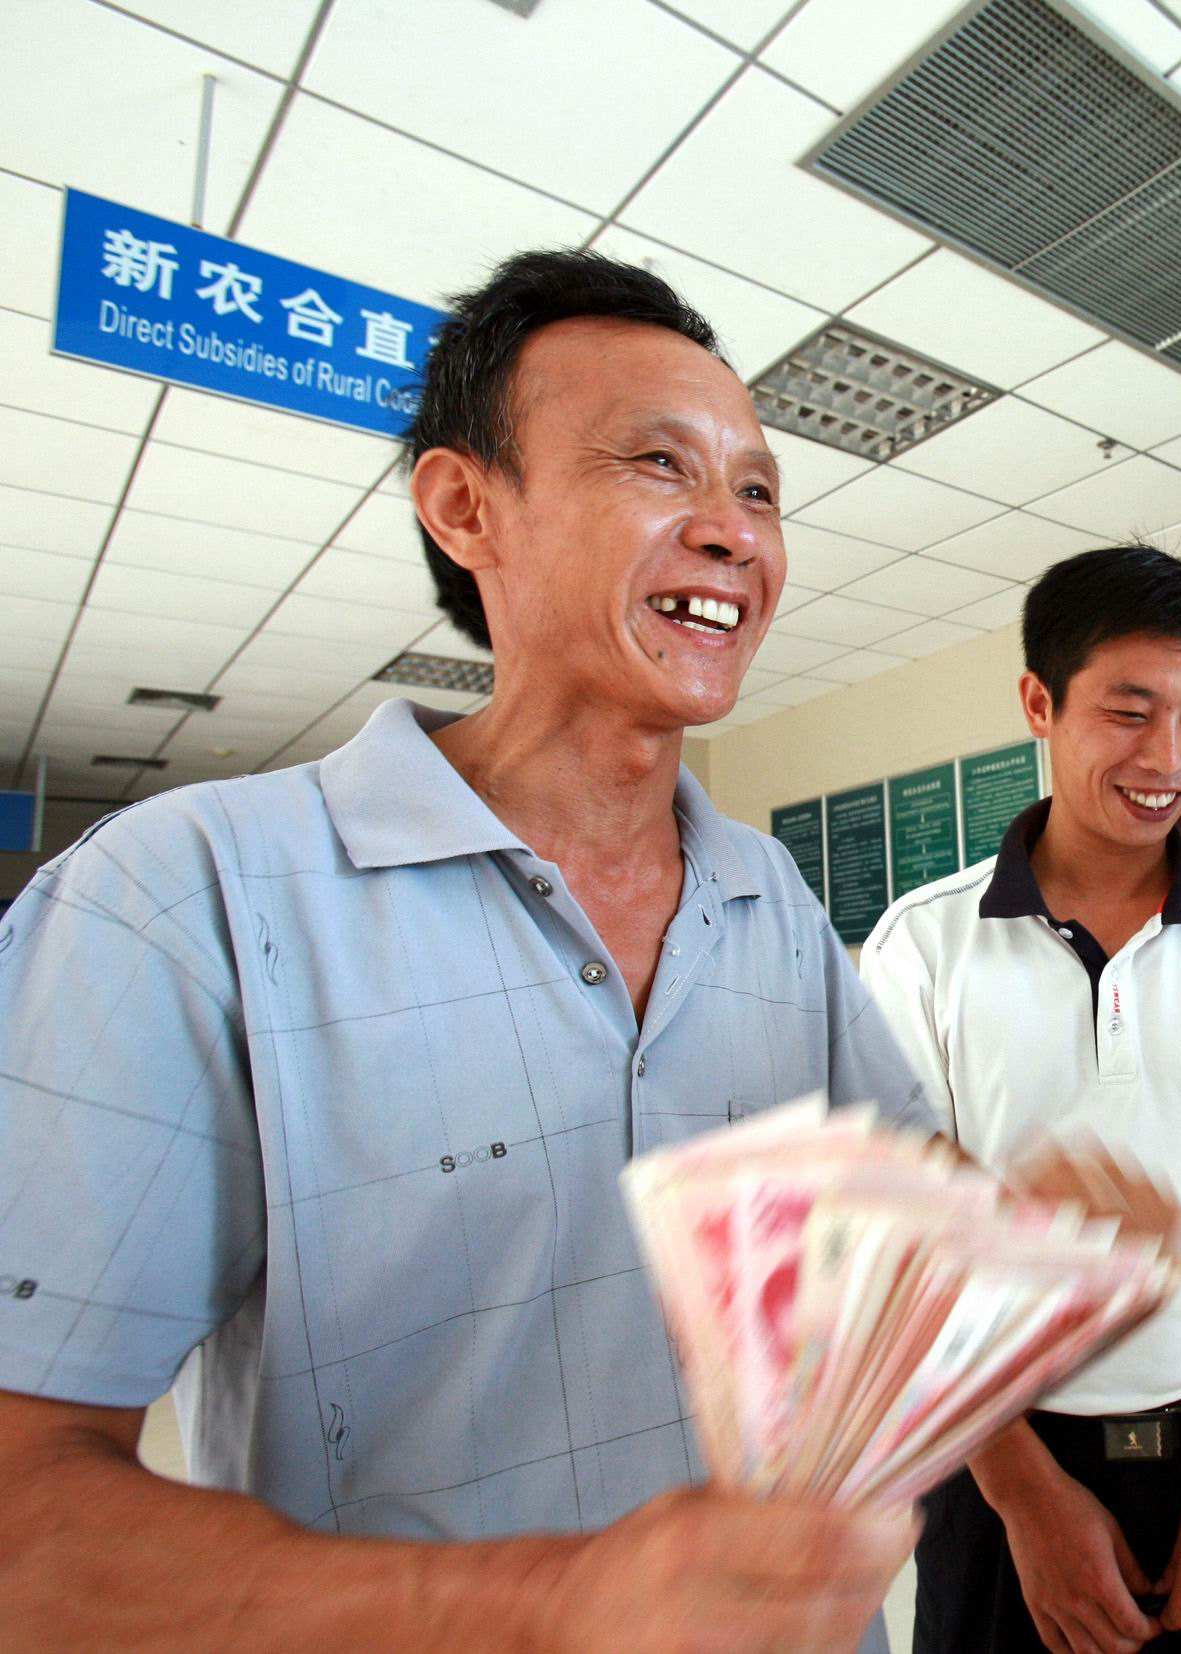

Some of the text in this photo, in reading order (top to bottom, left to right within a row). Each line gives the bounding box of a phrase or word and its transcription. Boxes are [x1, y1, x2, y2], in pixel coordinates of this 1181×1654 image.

[99, 299, 174, 351] Direct
[178, 322, 289, 382] Subsidies
[291, 357, 317, 388] of
[316, 361, 373, 404] Rural
[102, 228, 438, 370] 新农合直
